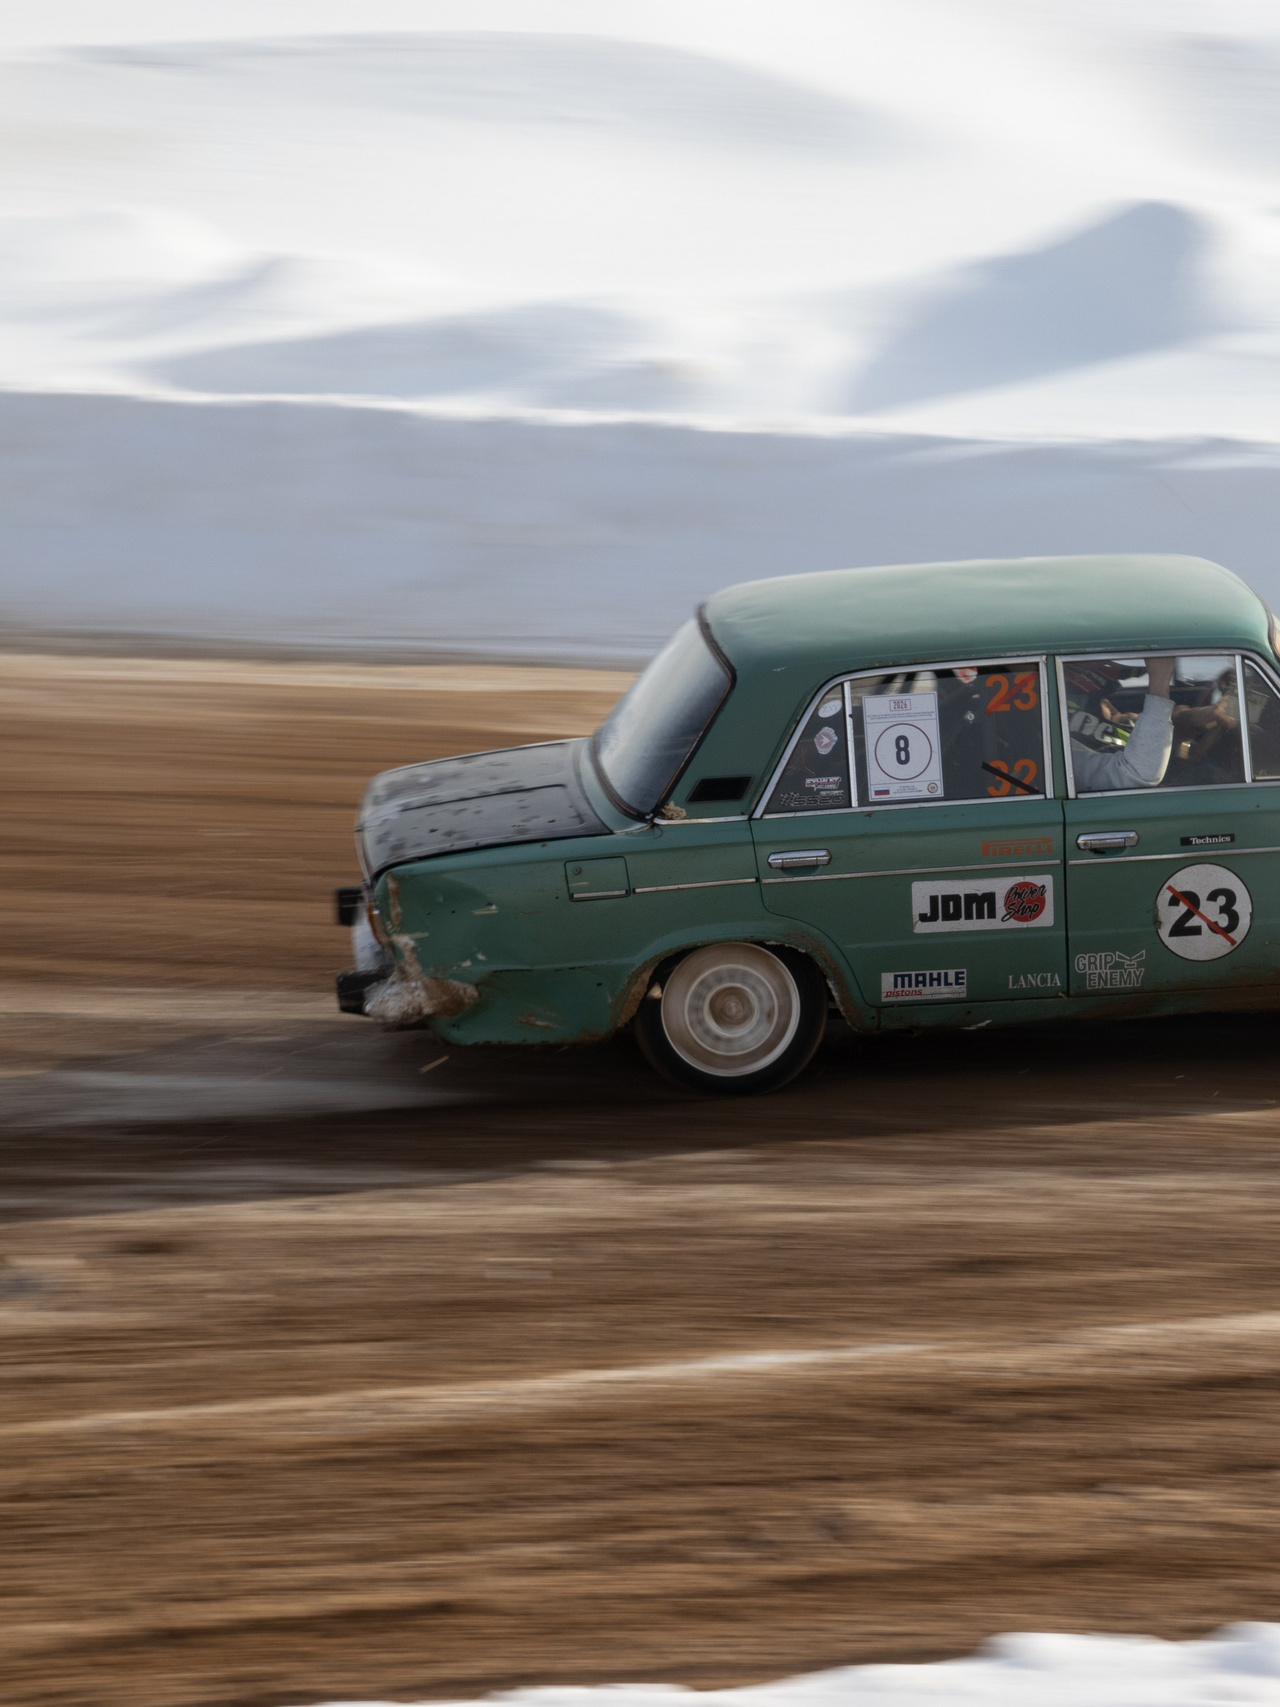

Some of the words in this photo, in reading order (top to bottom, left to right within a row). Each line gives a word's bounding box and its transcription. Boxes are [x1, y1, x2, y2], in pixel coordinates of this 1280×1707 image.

[985, 672, 1038, 711] 23
[894, 734, 911, 766] 8
[981, 837, 1053, 857] PIRELLI
[1190, 834, 1231, 845] Technics
[1004, 884, 1047, 906] Power
[918, 891, 997, 923] JDM
[1001, 899, 1041, 923] Shop
[1167, 887, 1240, 938] 23
[1075, 952, 1116, 974] GRIP
[893, 971, 966, 988] MAHLE
[1008, 973, 1062, 989] LANCIA
[1086, 968, 1145, 989] ENEMY
[884, 988, 923, 998] pistons
